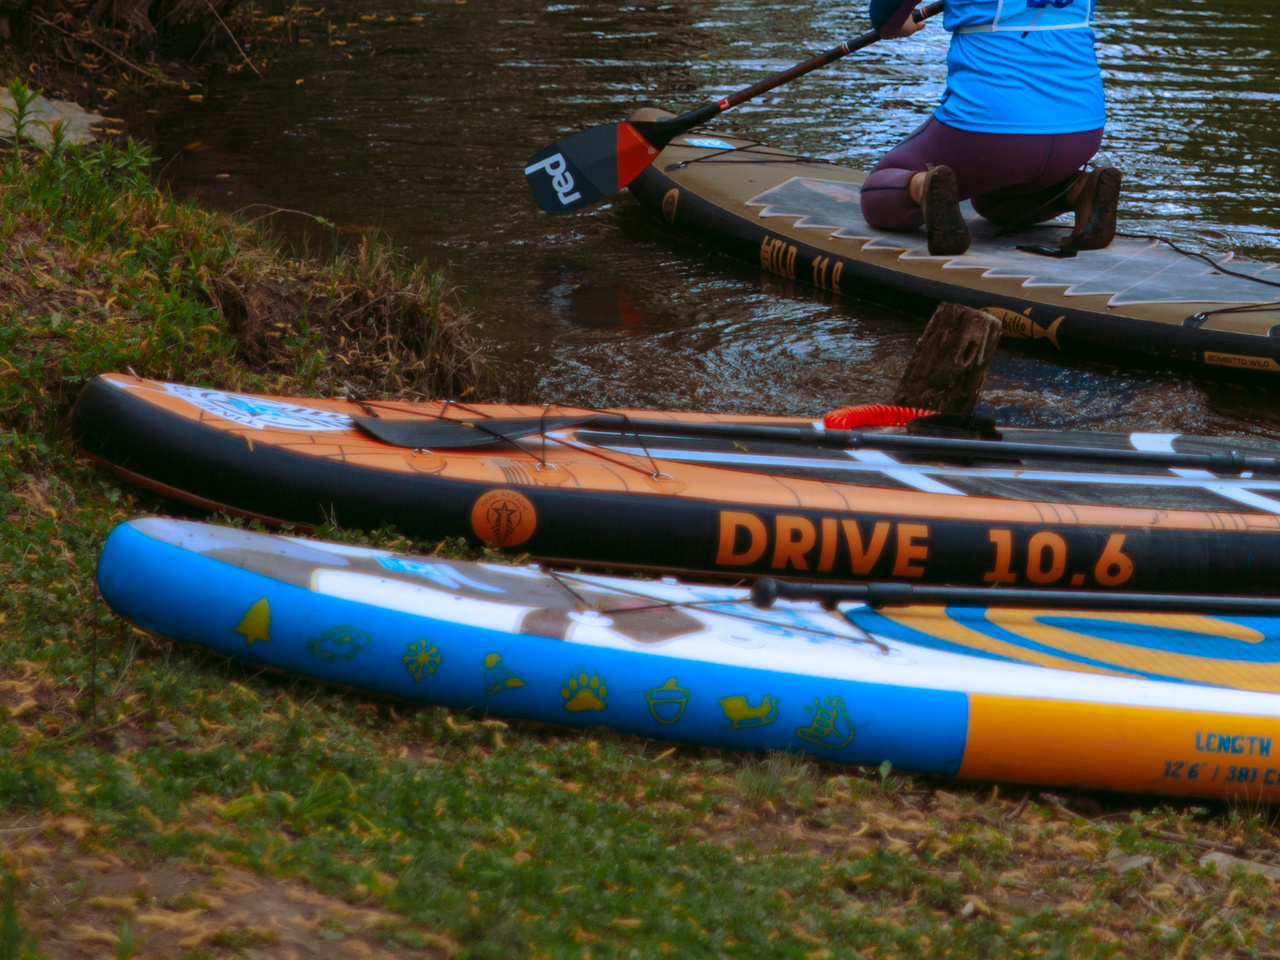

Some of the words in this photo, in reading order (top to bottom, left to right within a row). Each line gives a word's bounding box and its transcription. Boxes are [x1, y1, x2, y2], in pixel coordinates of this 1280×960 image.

[525, 152, 581, 205] red
[1249, 359, 1270, 368] WILD
[715, 509, 930, 578] DRIVE
[983, 527, 1135, 586] 10.6
[1194, 730, 1273, 757] LENGTH
